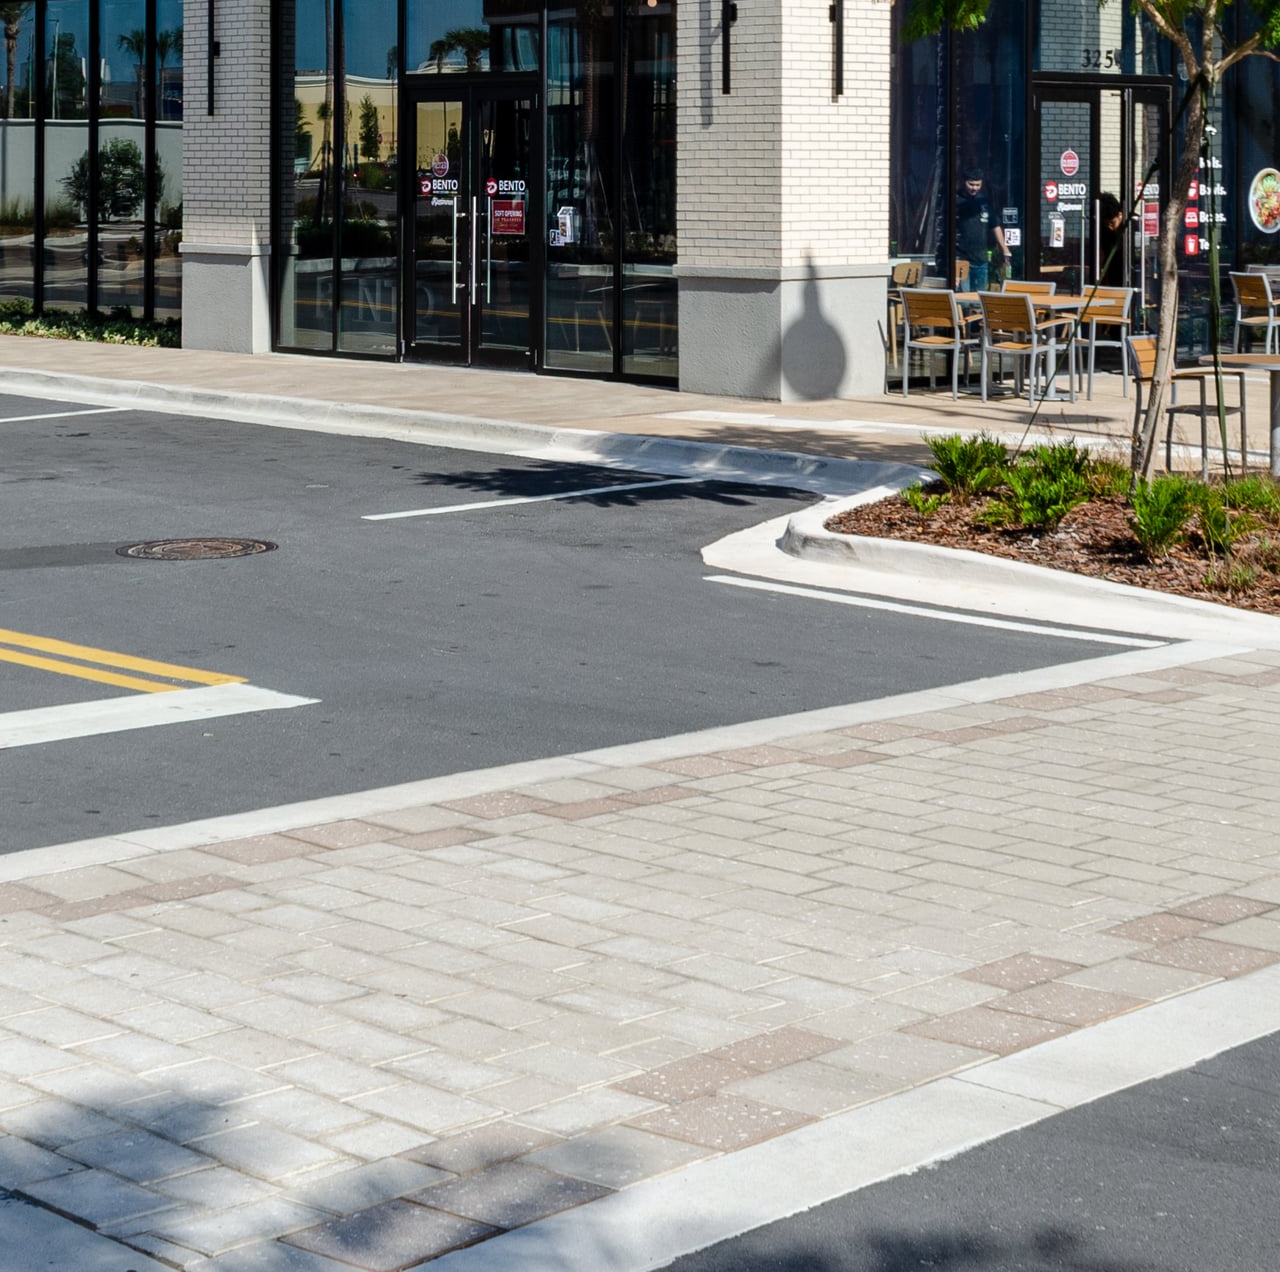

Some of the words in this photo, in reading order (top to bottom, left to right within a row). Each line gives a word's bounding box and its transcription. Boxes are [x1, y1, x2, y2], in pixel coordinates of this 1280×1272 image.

[432, 179, 459, 190] BENTO
[498, 180, 526, 191] BENTO
[1058, 184, 1087, 195] BENTO
